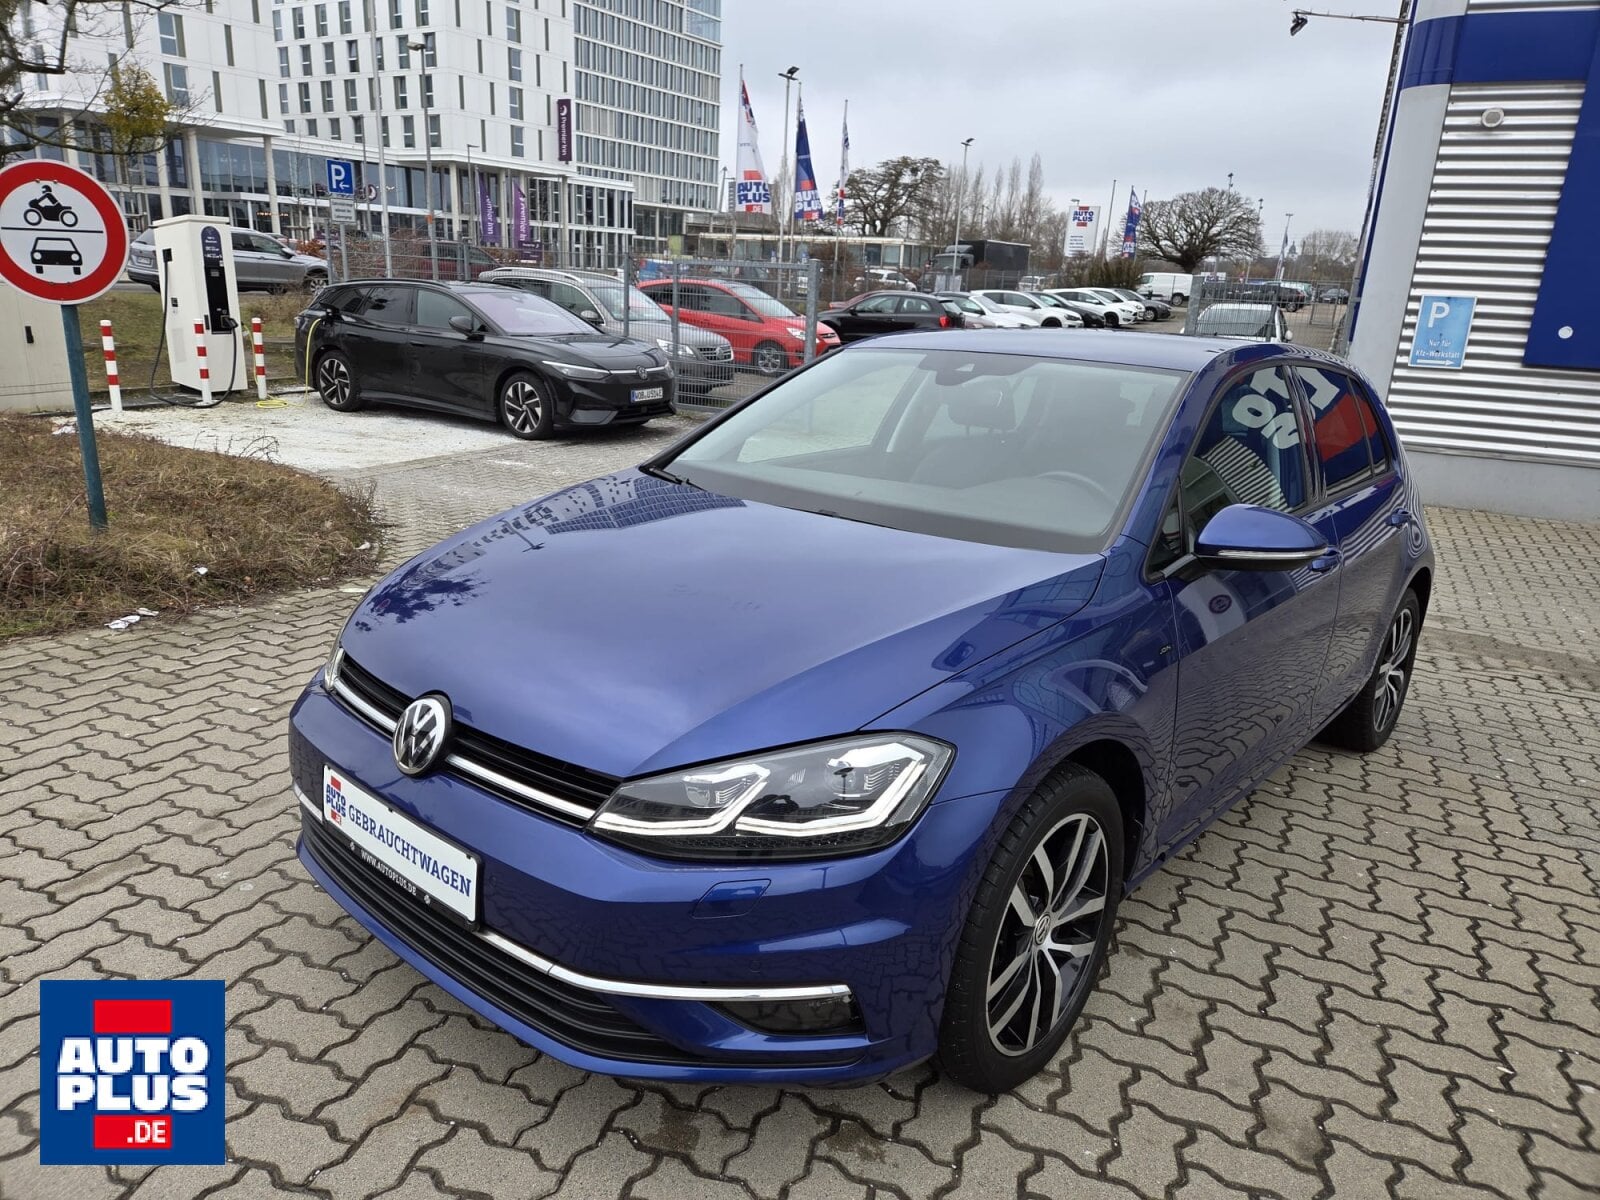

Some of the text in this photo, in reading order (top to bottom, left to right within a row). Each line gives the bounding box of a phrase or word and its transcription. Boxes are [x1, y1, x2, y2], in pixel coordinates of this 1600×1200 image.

[331, 164, 346, 189] P
[738, 192, 770, 204] PLUS
[1428, 302, 1450, 328] P
[1429, 339, 1440, 347] Nur
[326, 784, 347, 807] AUTO
[326, 794, 347, 818] PLUS
[348, 804, 472, 897] GEBRAUCHTWAGEN
[361, 850, 417, 896] WWW.AUTOPLUS.DE
